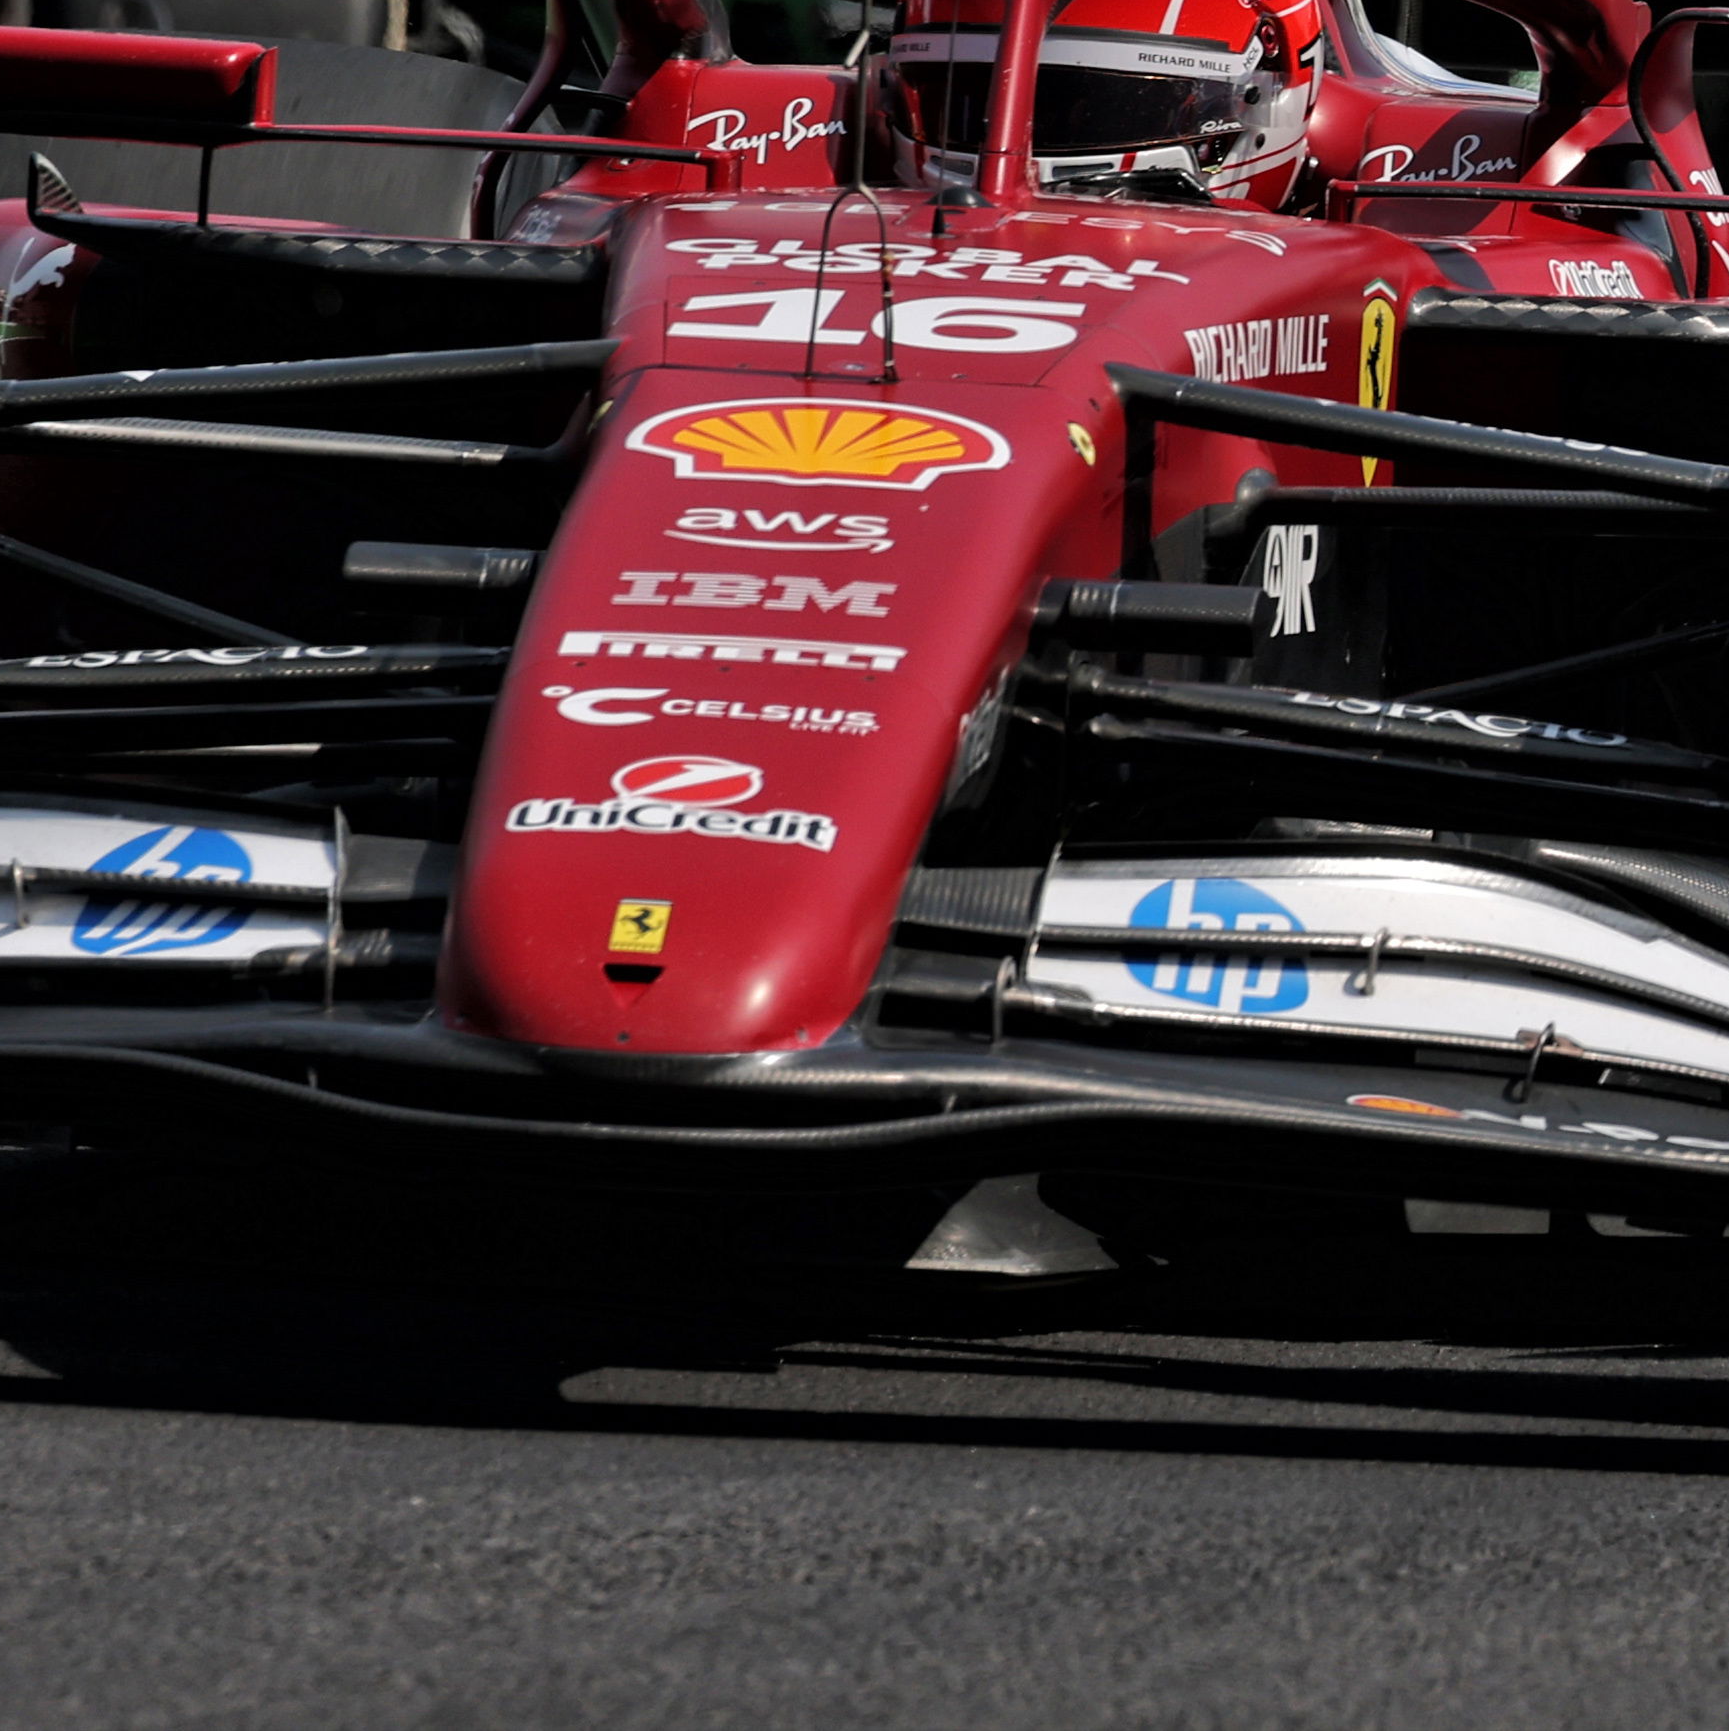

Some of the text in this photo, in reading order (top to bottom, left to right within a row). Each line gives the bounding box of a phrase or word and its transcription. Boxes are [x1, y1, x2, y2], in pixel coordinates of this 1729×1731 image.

[1137, 52, 1232, 74] RICHARD MILLE
[687, 97, 848, 165] Ray-Ban
[664, 237, 1190, 285] GLOBAL
[696, 252, 1135, 291] POKER
[666, 288, 1087, 353] 16
[1183, 314, 1330, 383] RICHARD MILLE
[675, 507, 890, 539] aws
[610, 571, 898, 618] IBM
[27, 645, 369, 669] ESPACIO
[558, 631, 908, 672] PIRELLI
[660, 698, 878, 728] CELSIUS
[789, 722, 833, 734] LIVE
[1290, 689, 1629, 748] ESPACIO
[506, 797, 838, 852] UniCredit
